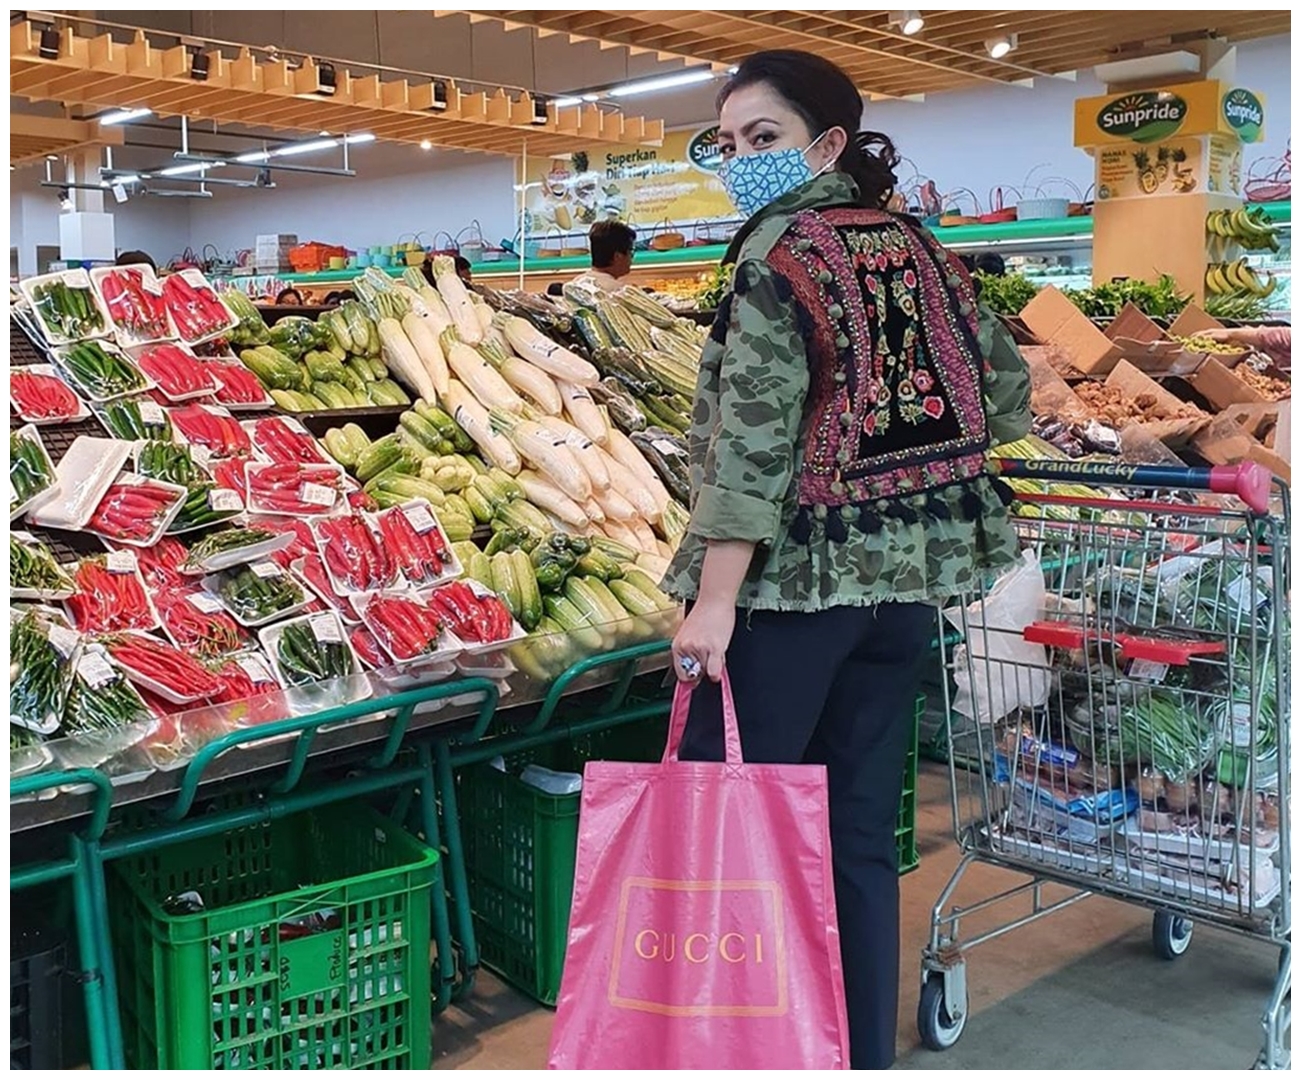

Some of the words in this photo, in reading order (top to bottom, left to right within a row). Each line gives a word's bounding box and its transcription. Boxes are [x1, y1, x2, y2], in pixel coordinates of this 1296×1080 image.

[1103, 103, 1180, 127] Sunpride
[1226, 101, 1261, 124] Sunpride
[606, 149, 657, 167] Superkan
[1025, 459, 1138, 480] GrandLucky
[635, 929, 763, 963] GUCCI
